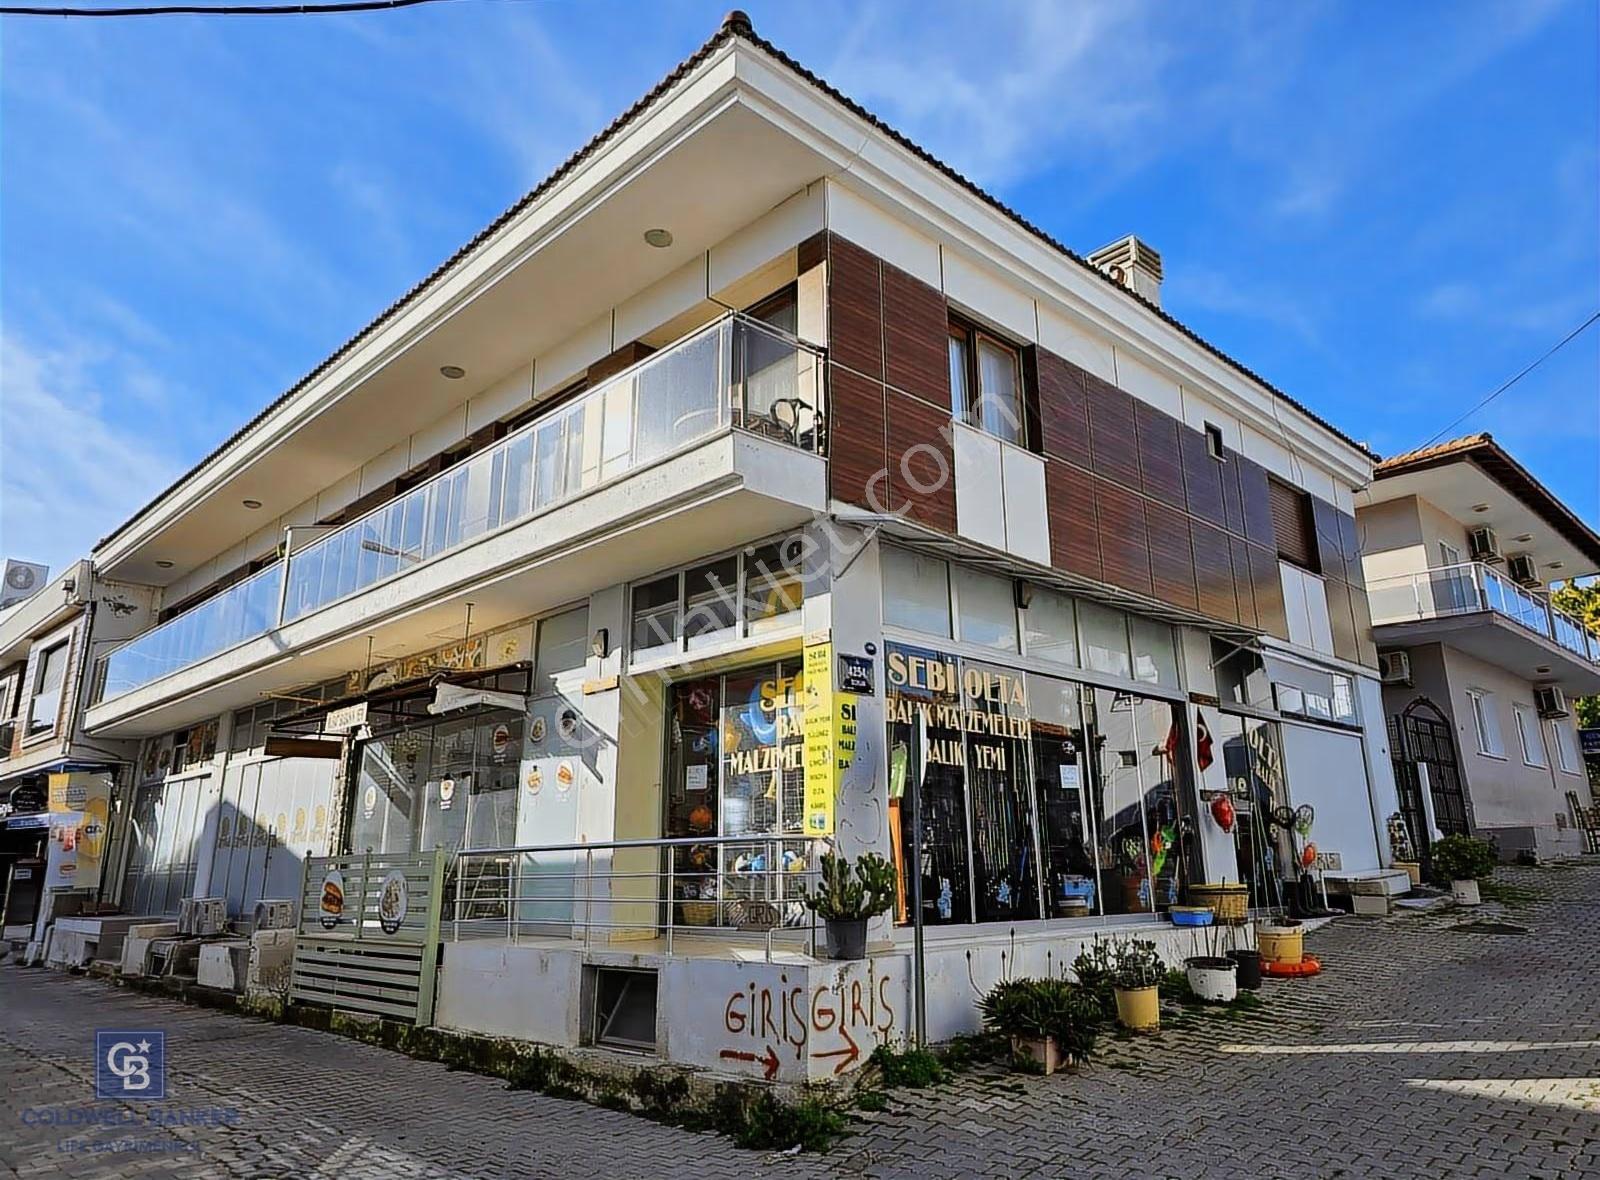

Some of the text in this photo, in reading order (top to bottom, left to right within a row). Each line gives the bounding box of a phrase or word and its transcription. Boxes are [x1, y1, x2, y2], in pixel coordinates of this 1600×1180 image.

[888, 652, 1025, 707] SEBİ OLTA
[974, 740, 1007, 771] YEMİ
[725, 974, 807, 1060] GİRİŞ
